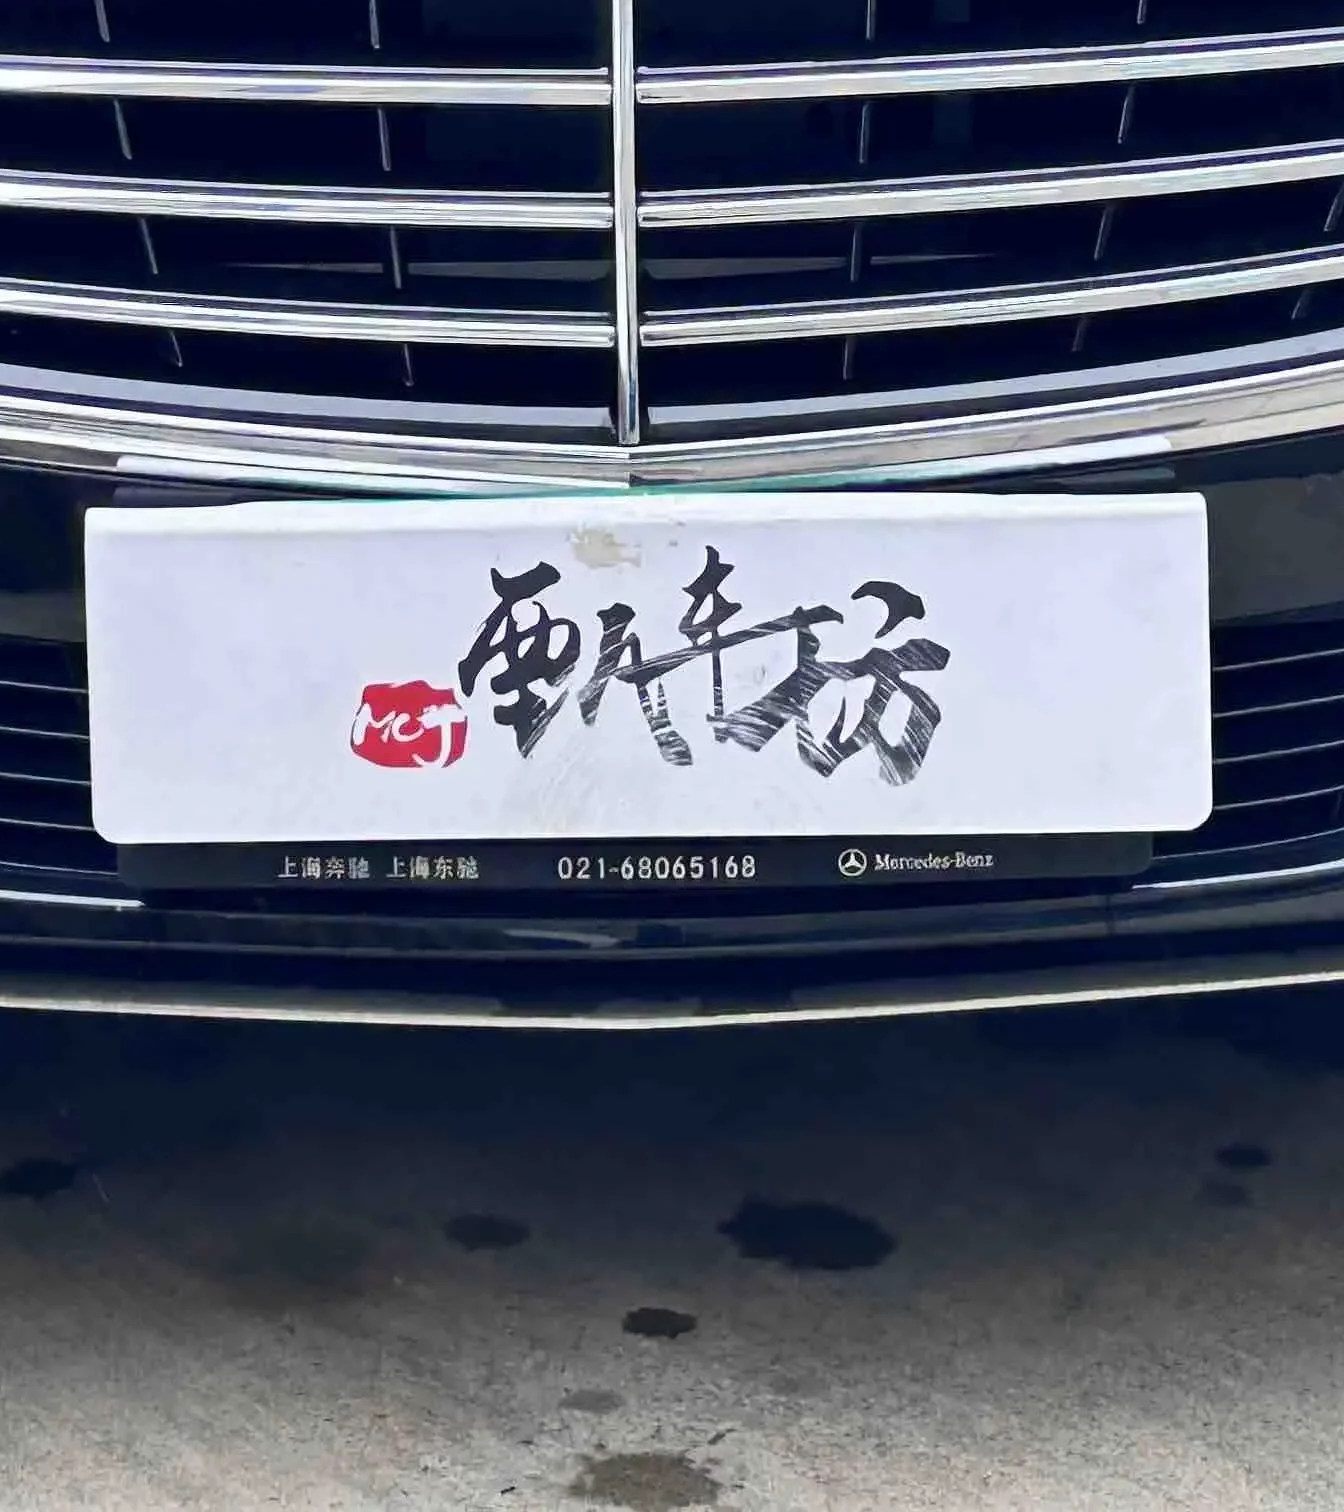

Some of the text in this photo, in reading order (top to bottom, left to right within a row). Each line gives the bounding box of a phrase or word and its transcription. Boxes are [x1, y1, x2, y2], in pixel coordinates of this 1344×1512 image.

[277, 855, 480, 880] 上海奔驰 上海东驰
[557, 855, 756, 880] 021-68065168
[873, 851, 995, 871] Mercedes-Benz
